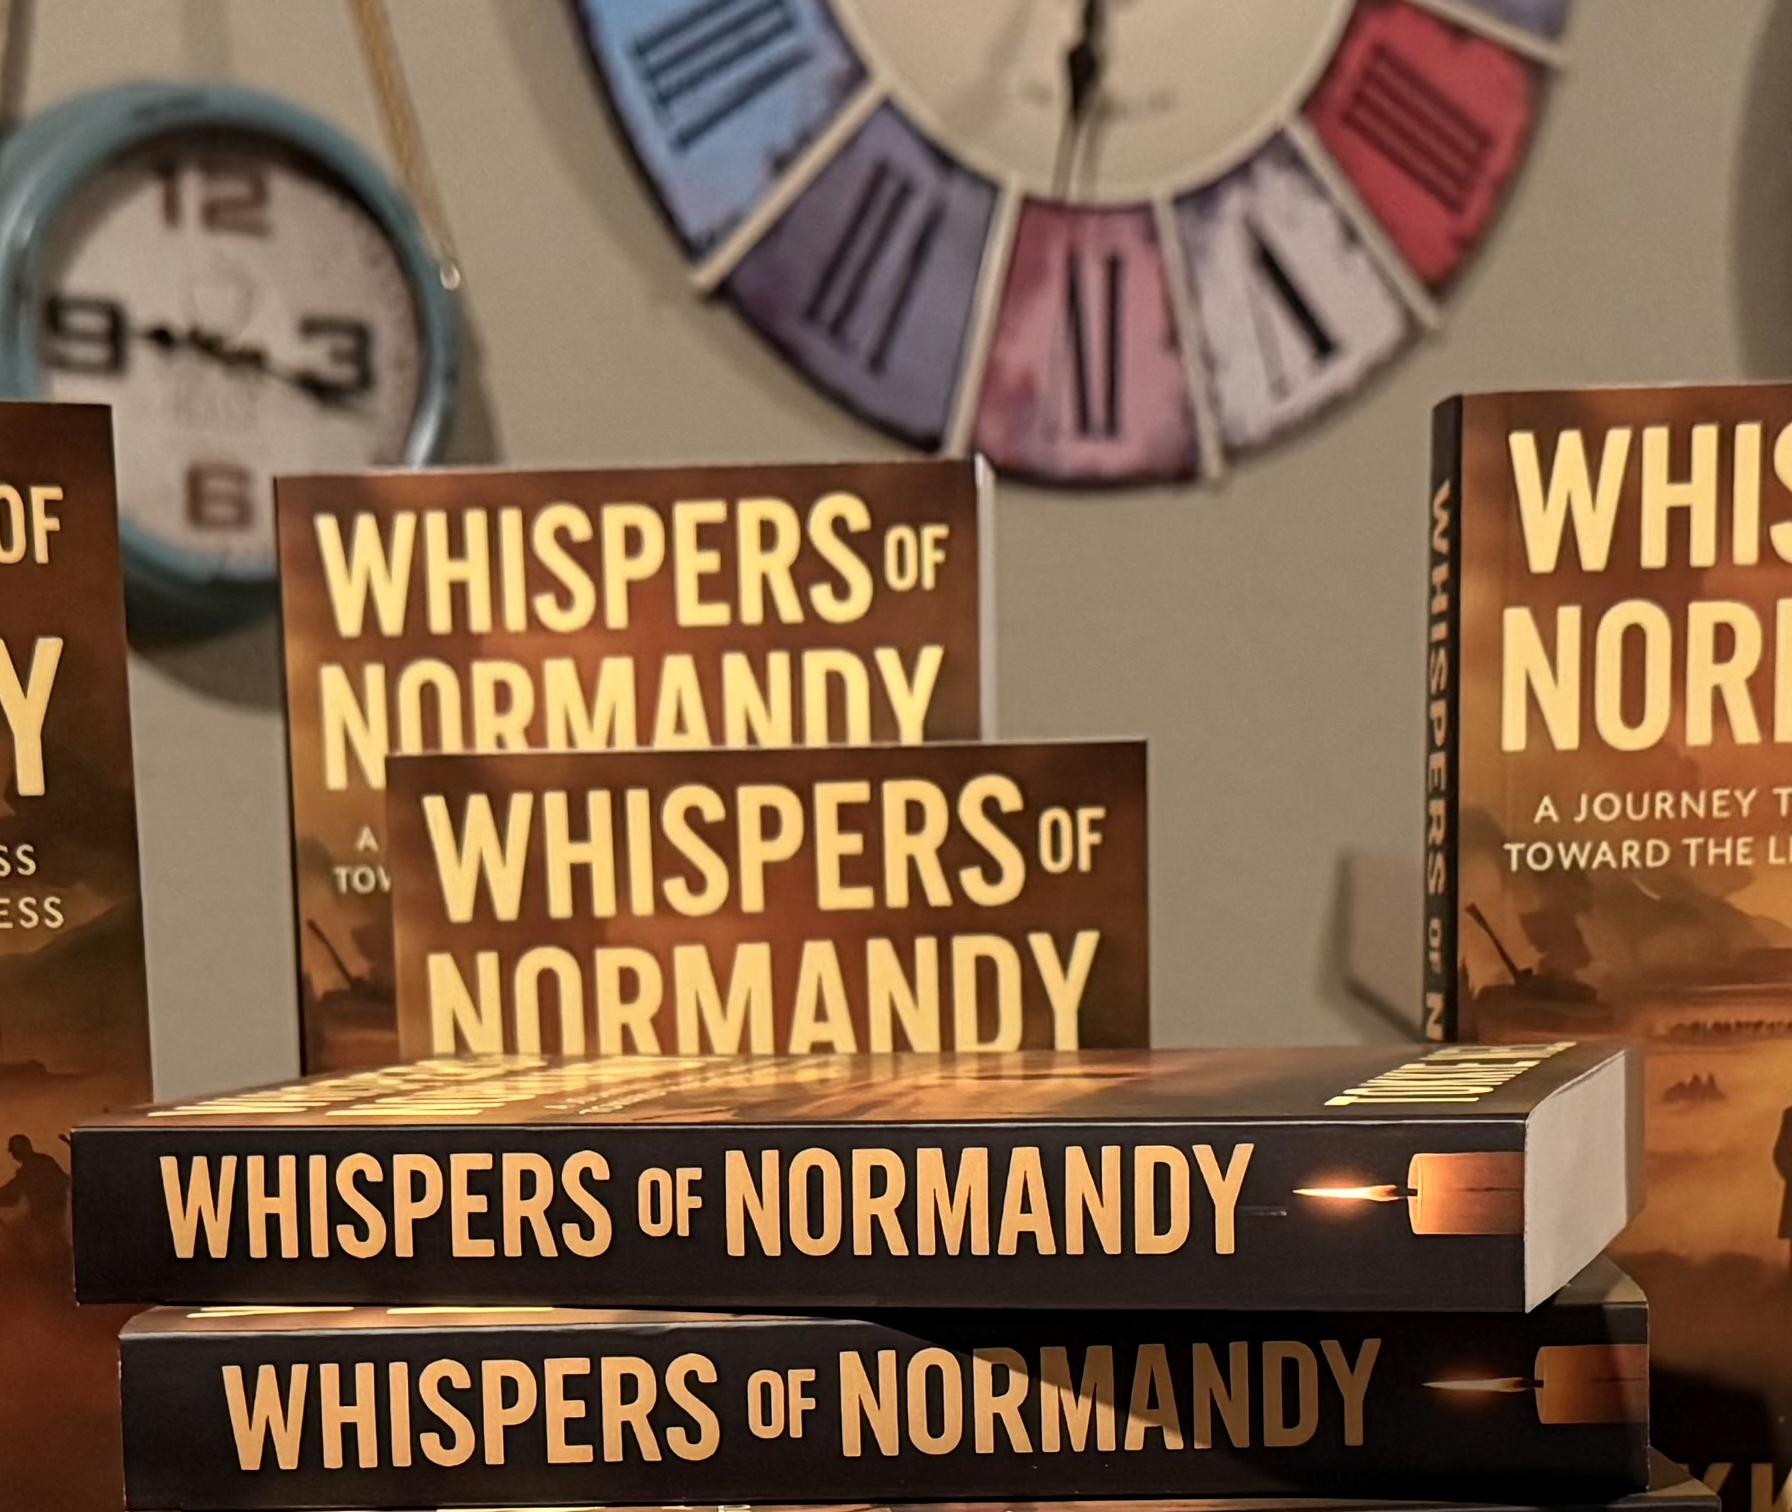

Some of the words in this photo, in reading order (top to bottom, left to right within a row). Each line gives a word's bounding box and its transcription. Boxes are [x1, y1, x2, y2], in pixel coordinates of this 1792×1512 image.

[41, 296, 125, 378] 9
[297, 316, 376, 402] 3
[183, 458, 255, 533] 6
[315, 493, 873, 638] WHISPERS
[884, 524, 949, 591] OF
[318, 645, 944, 789] NORMANDY
[1425, 480, 1450, 897] WHISPERS
[422, 774, 1025, 923] WHISPERS
[1039, 807, 1106, 873] OF
[1503, 838, 1671, 872] TOWARD
[1681, 836, 1755, 867] THE
[1533, 795, 1559, 824] A
[1573, 787, 1758, 823] JOURNEY
[425, 929, 1101, 1056] NORMANDY
[159, 1149, 613, 1259] WHISPERS
[637, 1167, 703, 1237] OF
[725, 1142, 1255, 1257] NORMANDY
[221, 1352, 722, 1472] WHISPERS
[747, 1367, 816, 1440] OF
[838, 1337, 1383, 1458] NORMANDY
